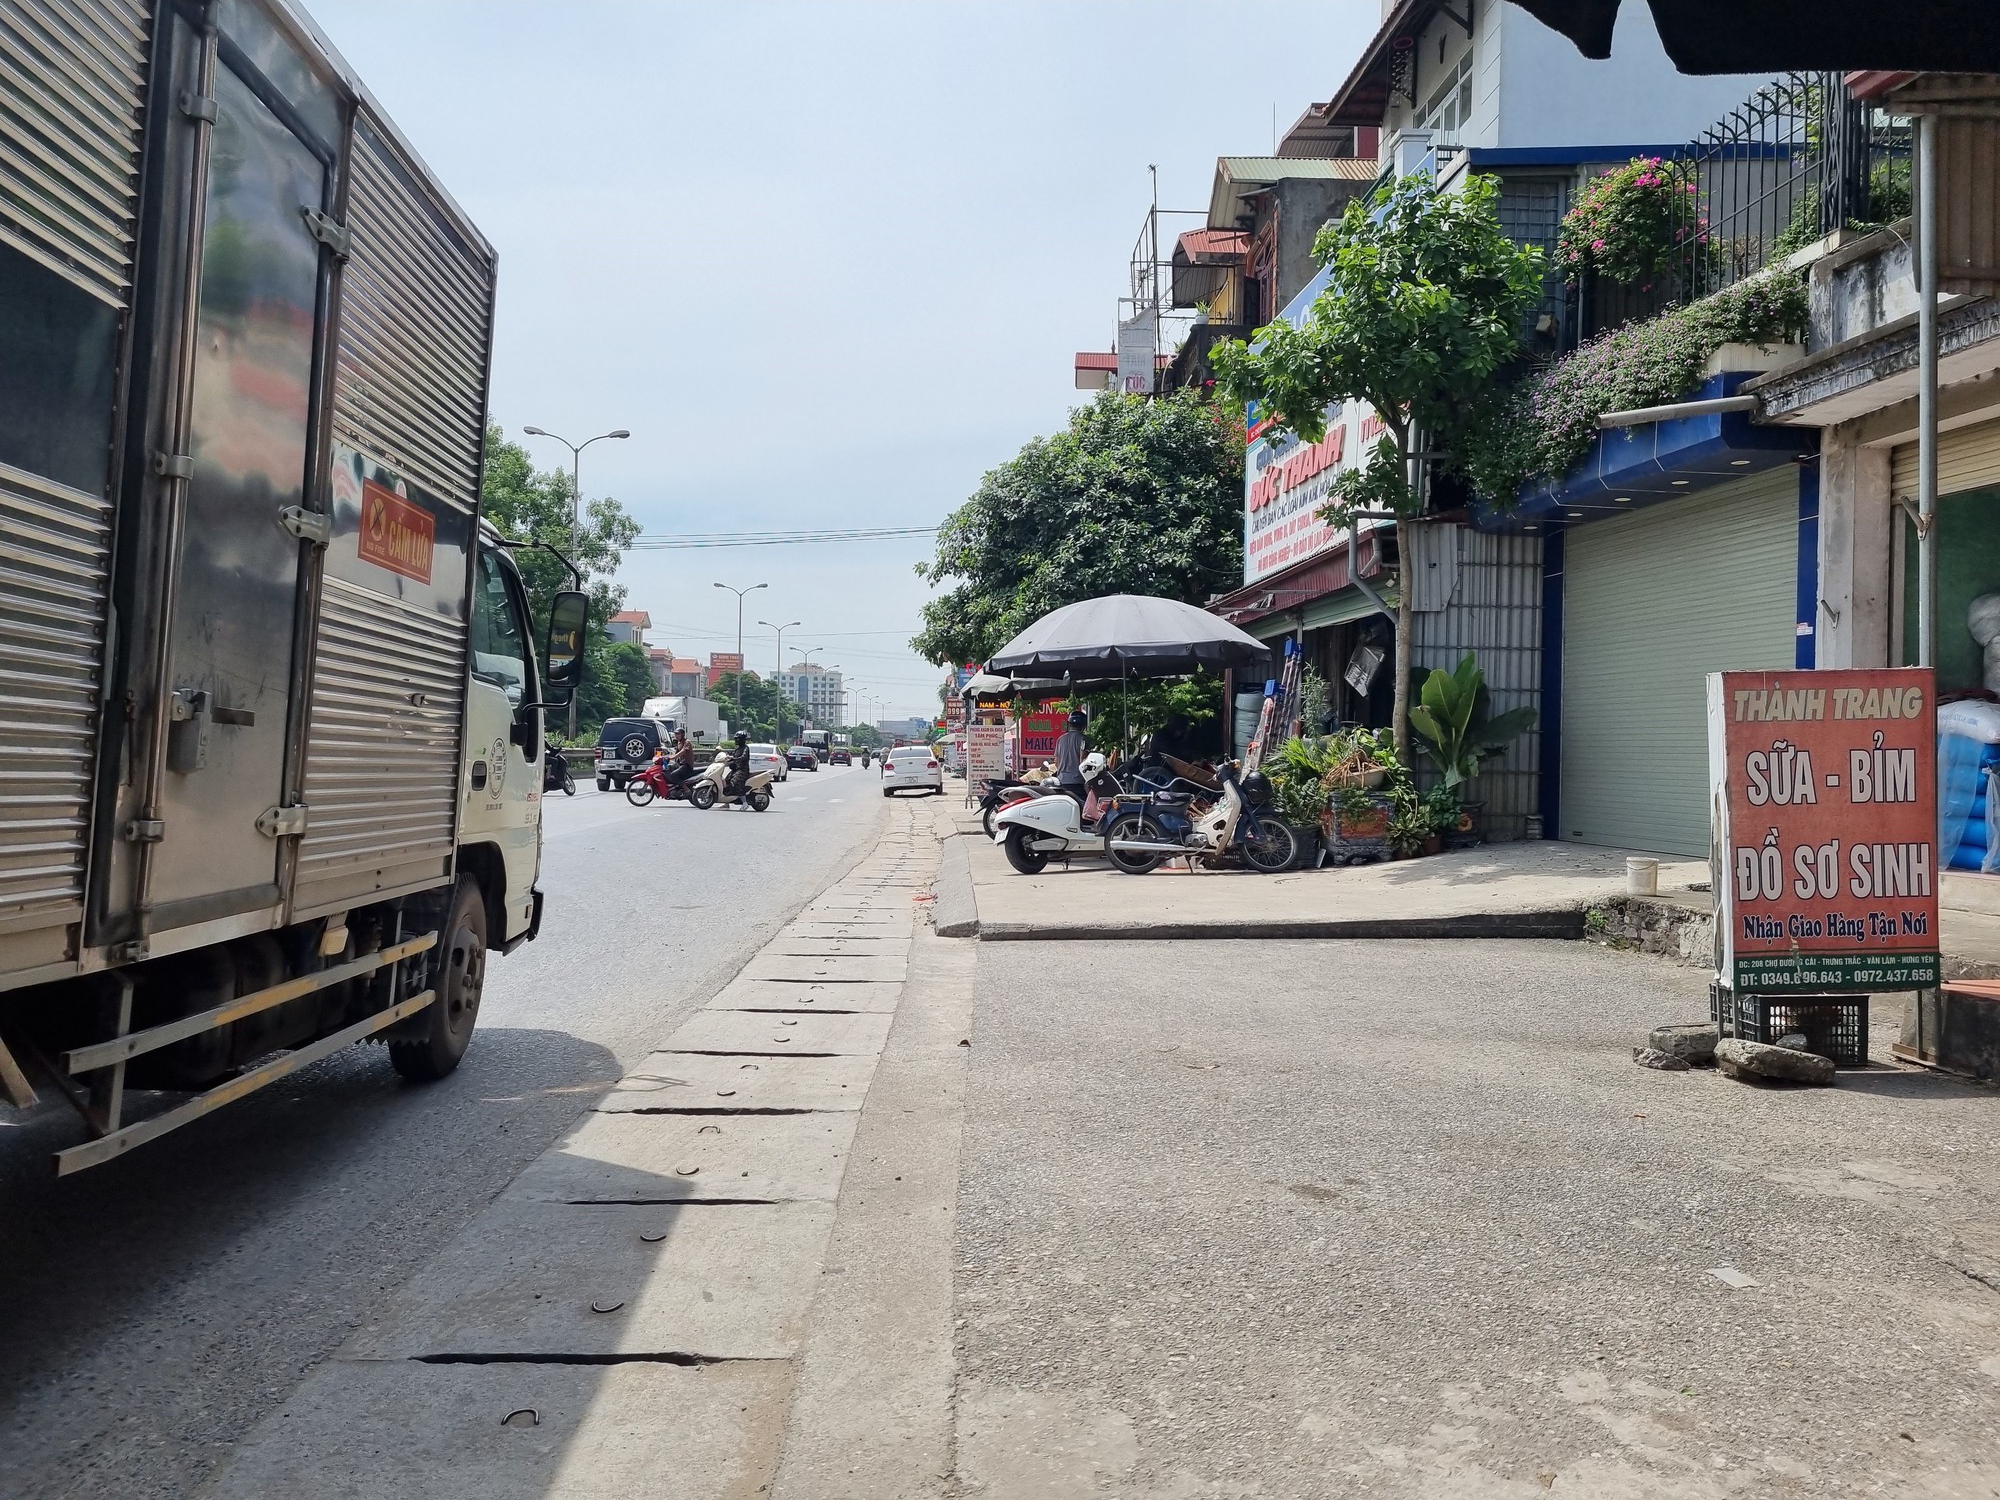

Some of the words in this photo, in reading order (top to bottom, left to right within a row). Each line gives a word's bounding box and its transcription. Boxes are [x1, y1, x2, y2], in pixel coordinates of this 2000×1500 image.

[1250, 465, 1281, 512] ĐỨC
[374, 544, 386, 556] FIRE
[388, 513, 411, 562] CẤM
[412, 520, 428, 571] LỬA
[1734, 681, 1826, 722] THÀNH
[1832, 686, 1923, 720] TRANG
[1028, 719, 1052, 732] NAIL
[1025, 737, 1054, 750] MAKE
[1746, 739, 1817, 806] SỮA
[1849, 730, 1917, 803] BỈM
[1736, 827, 1784, 901] ĐỒ
[1793, 839, 1840, 900] SƠ
[1849, 843, 1931, 899] SINH
[1743, 913, 1784, 945] Nhận
[1788, 912, 1822, 938] Giao
[1826, 912, 1865, 943] Hàng
[1868, 911, 1898, 943] Tận
[1901, 911, 1928, 936] Nơi
[1740, 974, 1758, 986] ĐT:
[1854, 969, 1934, 982] 0972.437.658
[1764, 959, 1778, 968] CHỢ
[1822, 957, 1844, 966] TRƯNG
[1882, 956, 1896, 964] LÂM
[1921, 954, 1934, 964] YÊN
